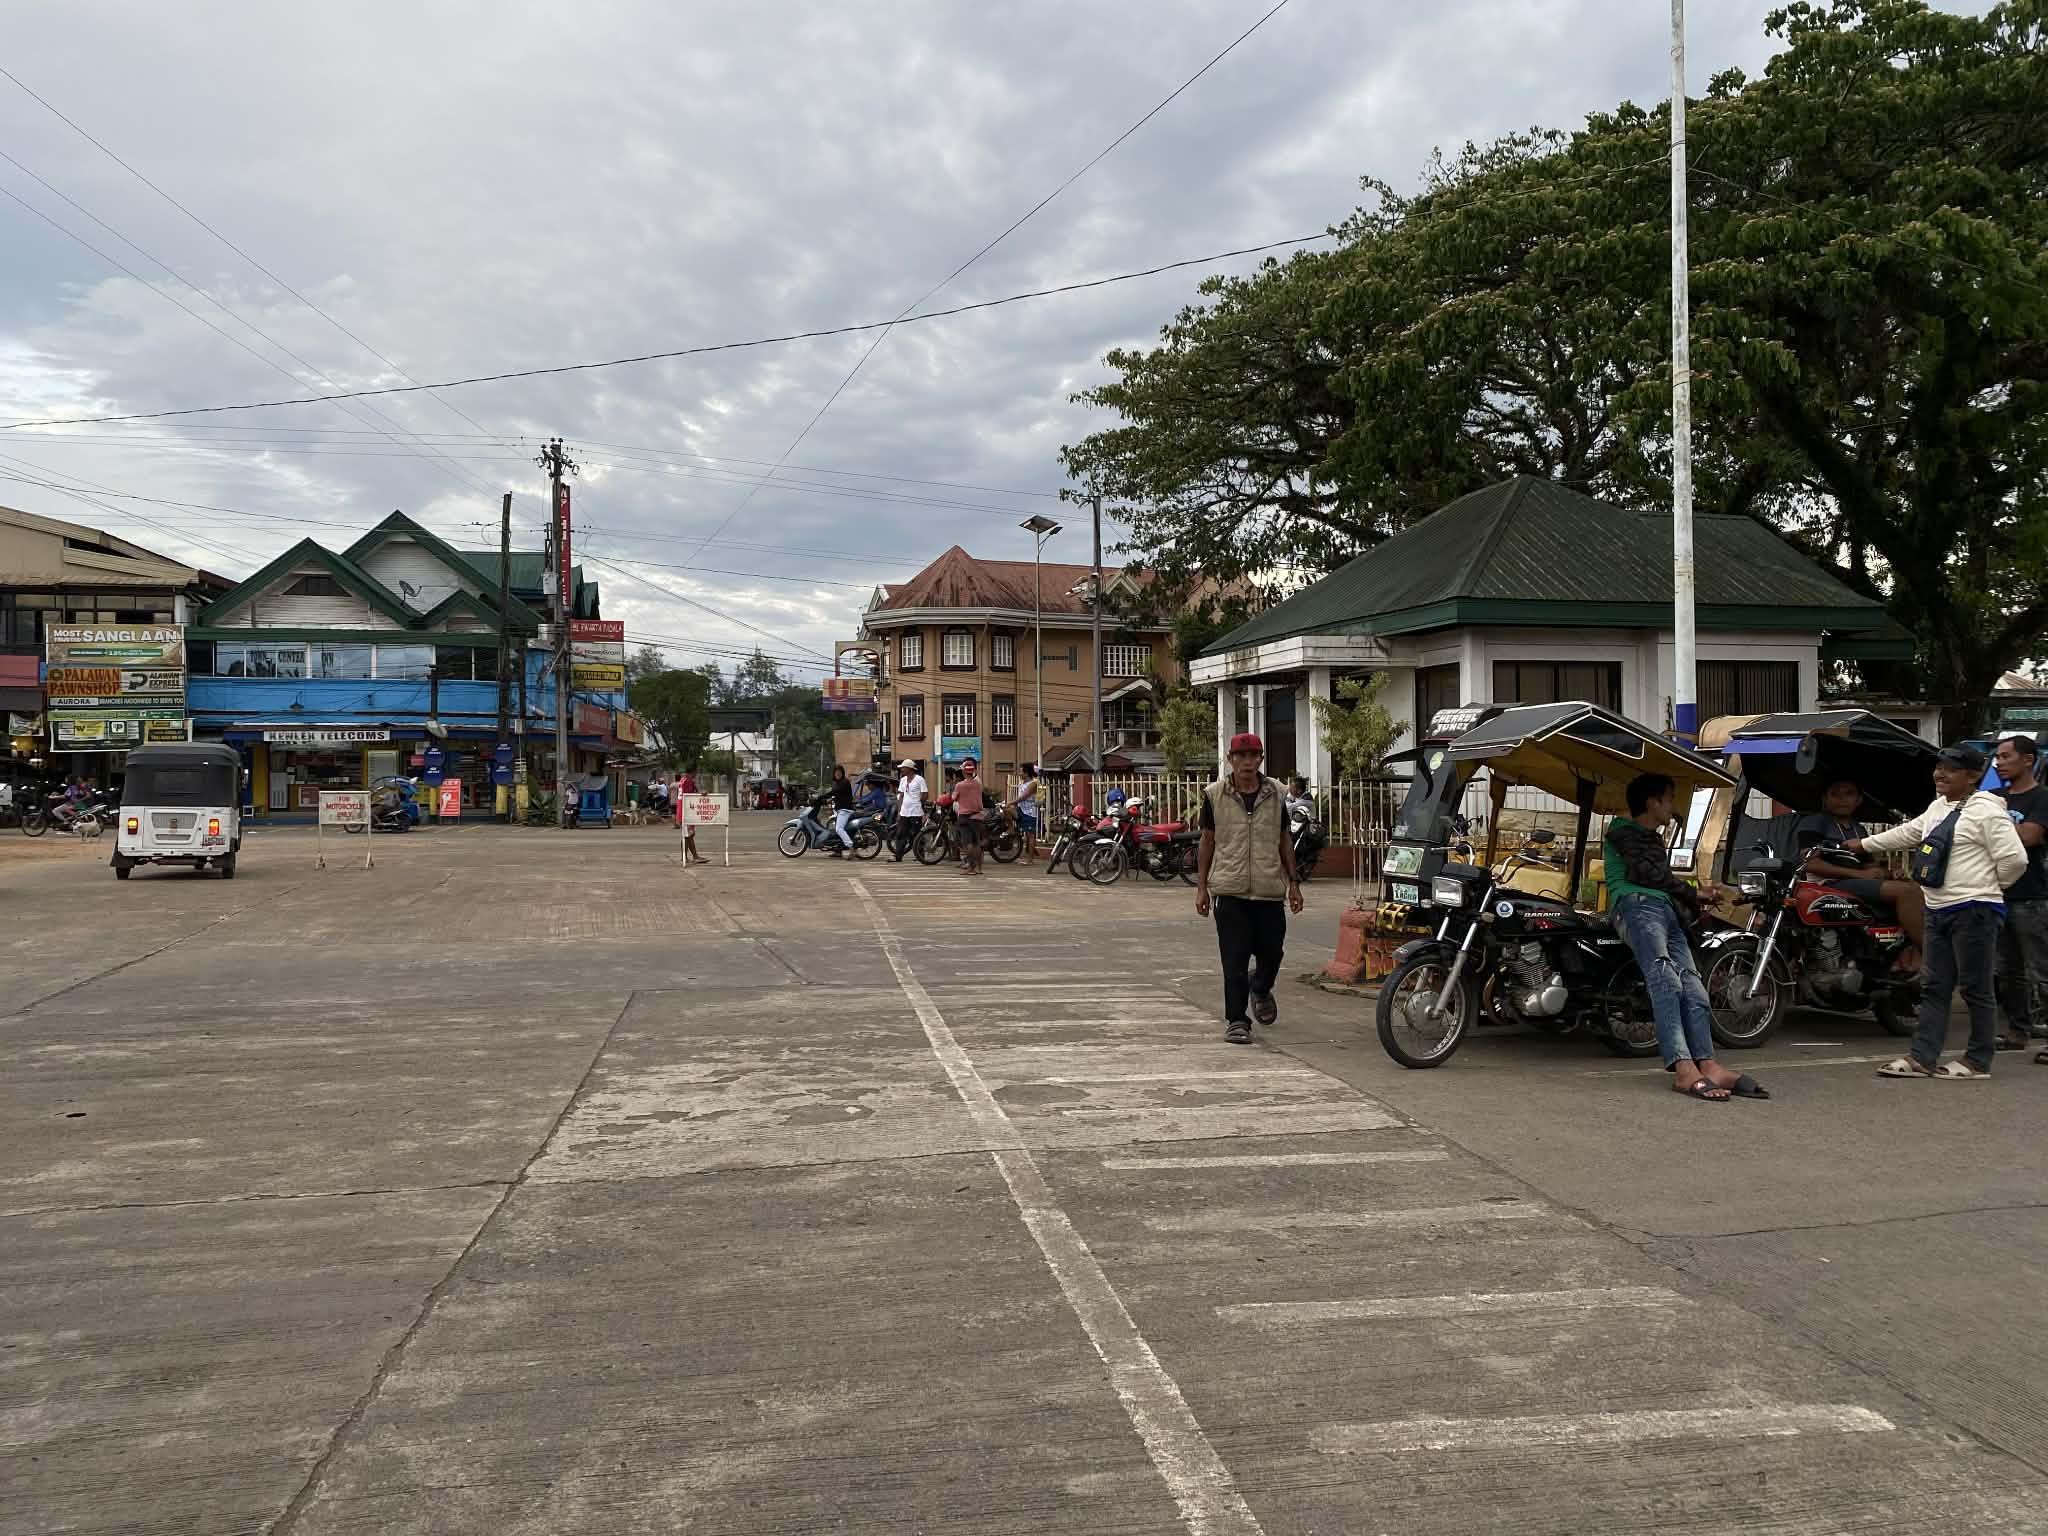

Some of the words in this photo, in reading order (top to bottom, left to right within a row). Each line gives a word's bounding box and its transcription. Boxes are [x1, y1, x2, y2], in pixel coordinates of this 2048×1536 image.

[53, 629, 82, 637] MOST
[83, 630, 177, 642] SANGLAAN
[63, 668, 120, 681] PALAWAN
[49, 681, 120, 695] PAWNSHOP
[320, 732, 385, 740] TELECOMS
